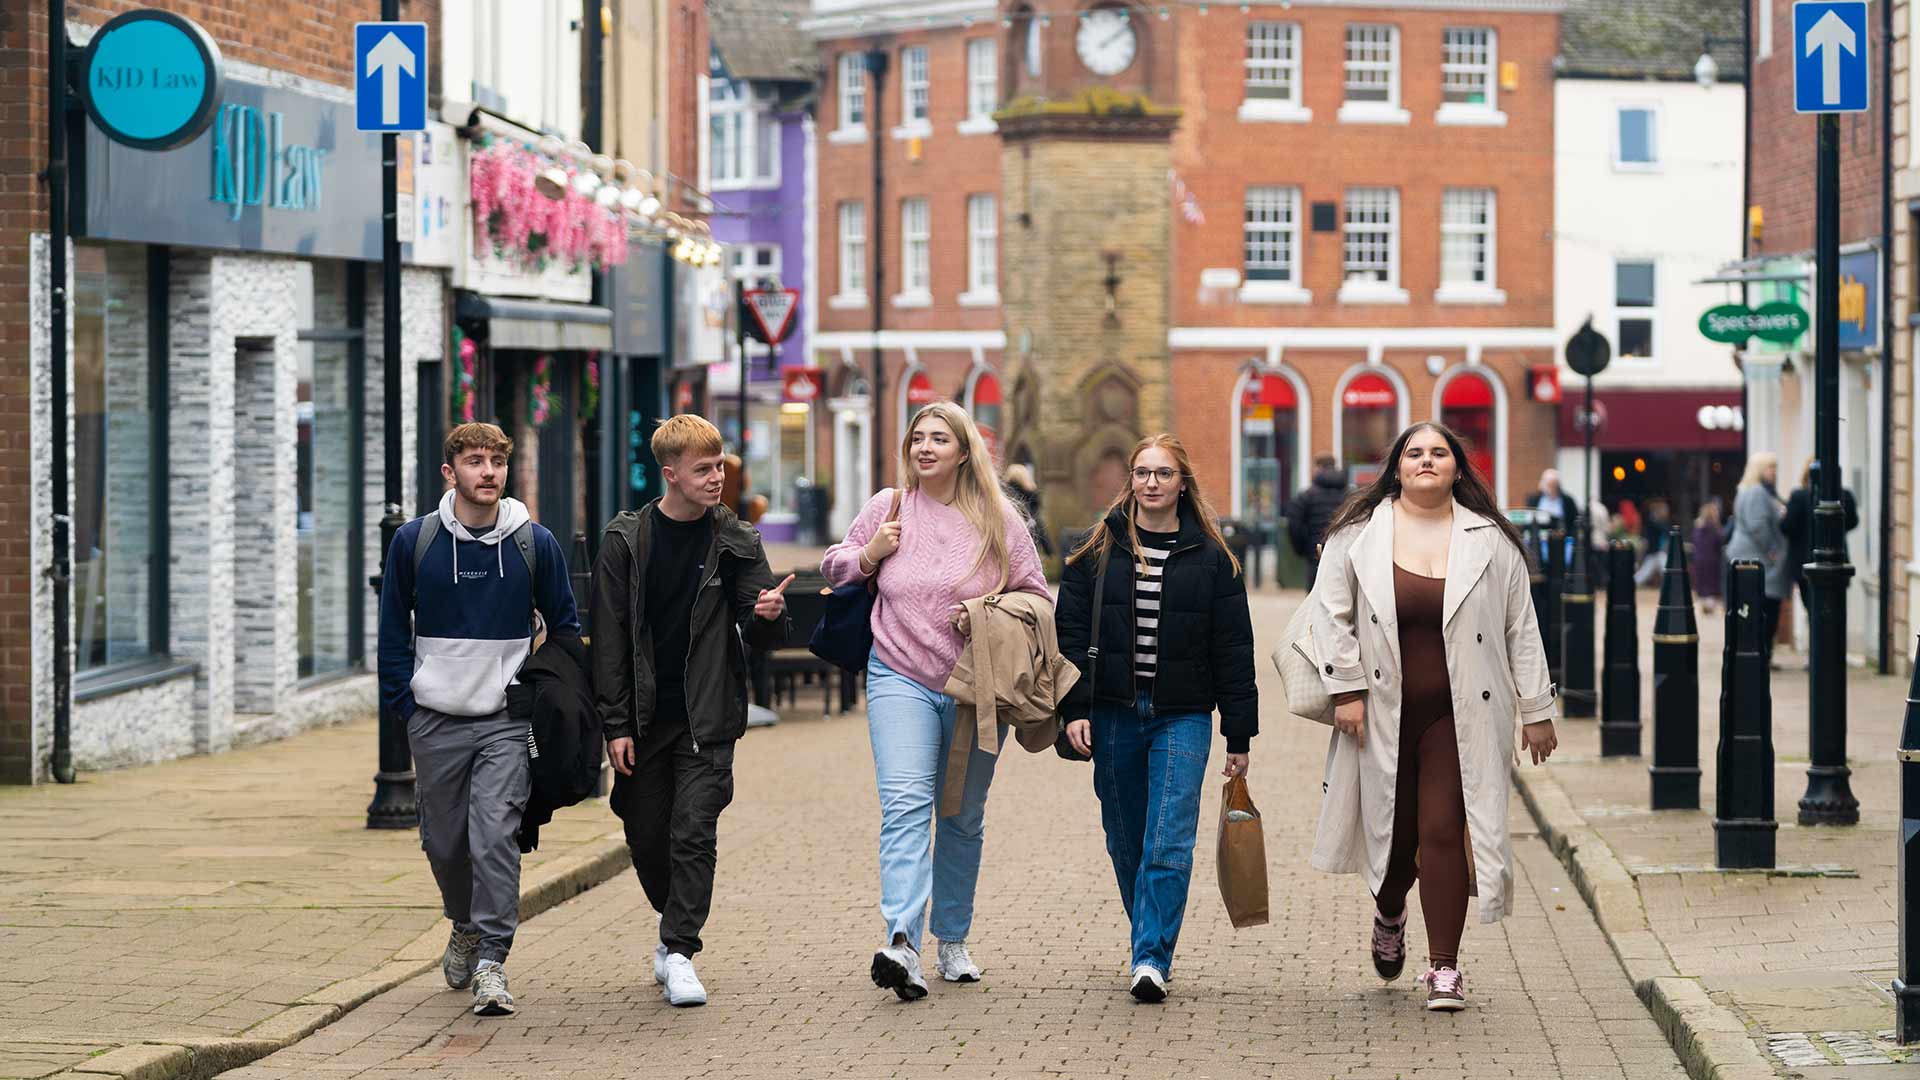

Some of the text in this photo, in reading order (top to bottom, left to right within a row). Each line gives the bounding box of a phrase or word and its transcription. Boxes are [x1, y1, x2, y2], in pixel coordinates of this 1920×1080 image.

[96, 67, 201, 92] KJD Law
[212, 103, 266, 221] KJD
[270, 111, 327, 211] Law
[1708, 313, 1800, 334] Specsavers
